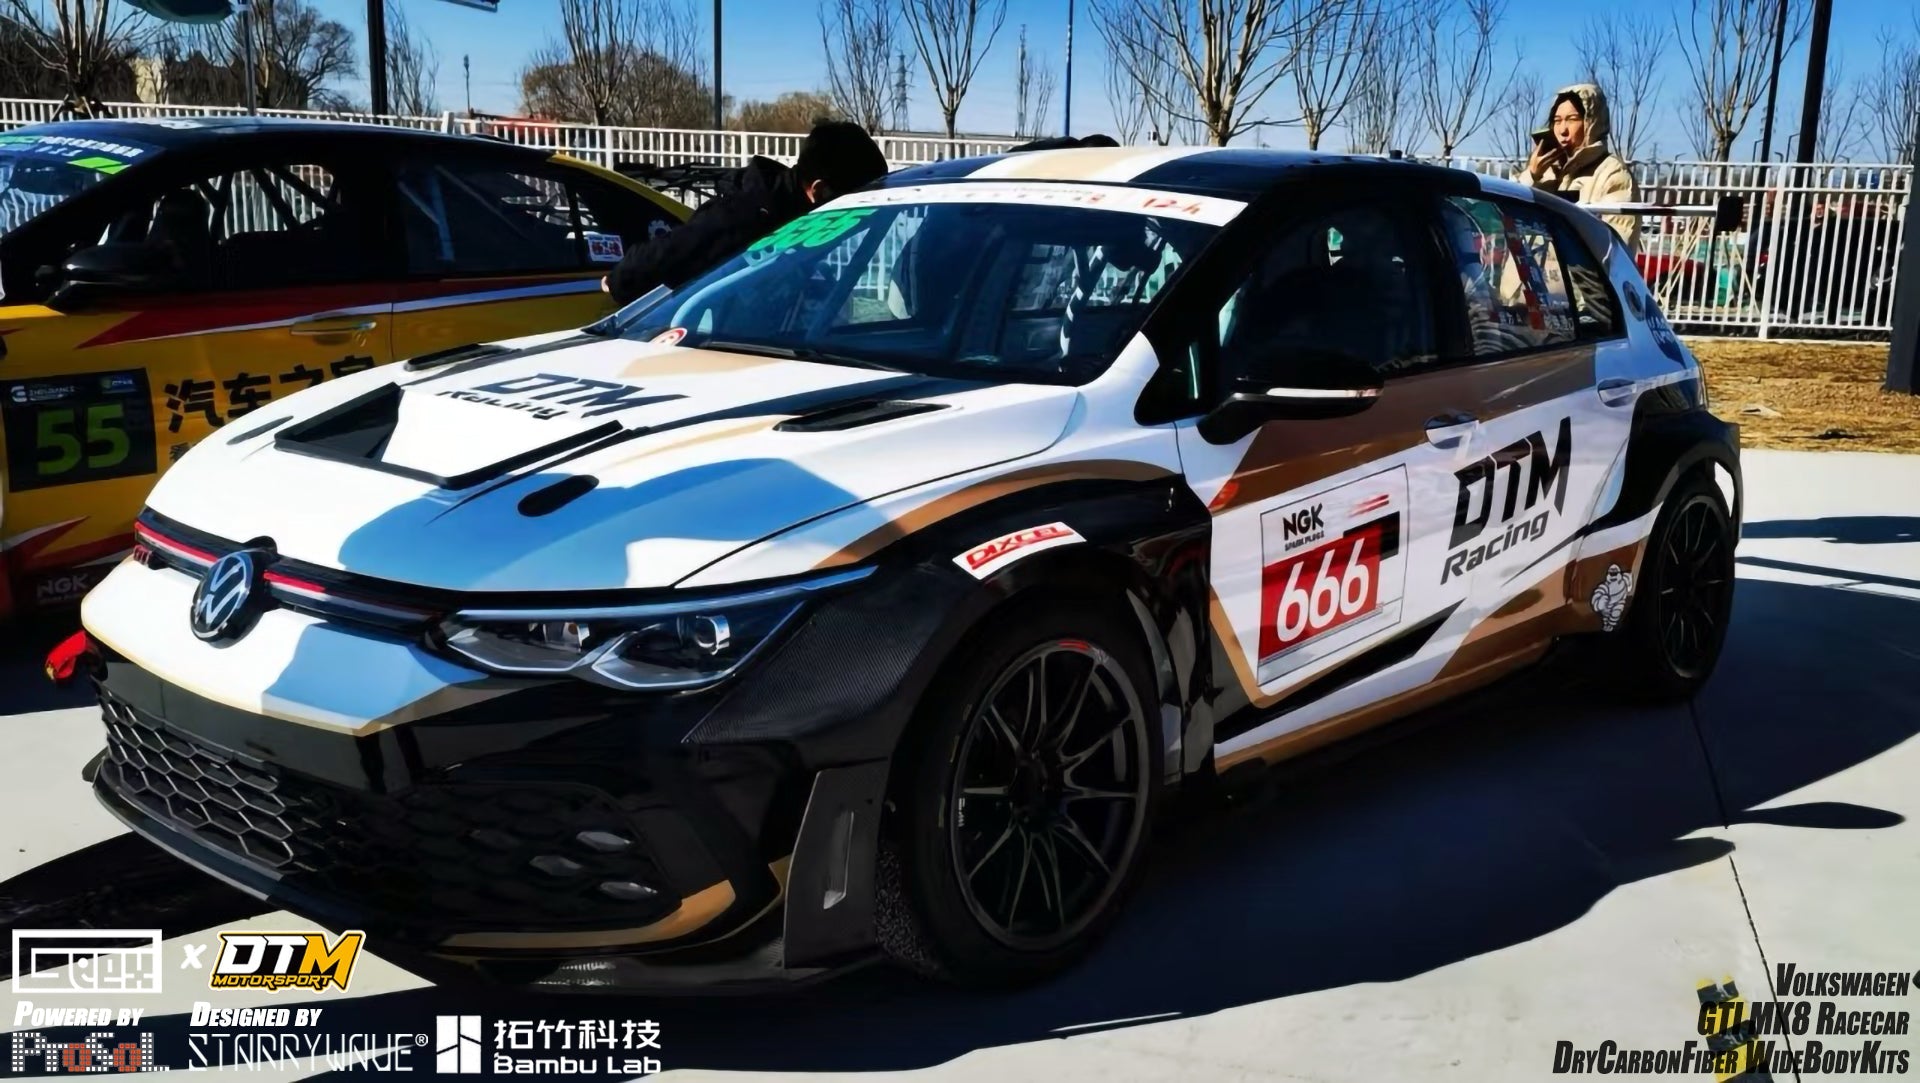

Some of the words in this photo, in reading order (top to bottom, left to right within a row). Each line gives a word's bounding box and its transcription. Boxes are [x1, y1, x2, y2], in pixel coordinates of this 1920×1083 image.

[471, 373, 691, 418] DTM
[37, 403, 130, 475] 55
[1449, 416, 1571, 551] DTM
[1283, 502, 1324, 541] NGK
[1440, 510, 1550, 585] Racing
[36, 573, 89, 598] NGK
[1276, 537, 1370, 643] 666
